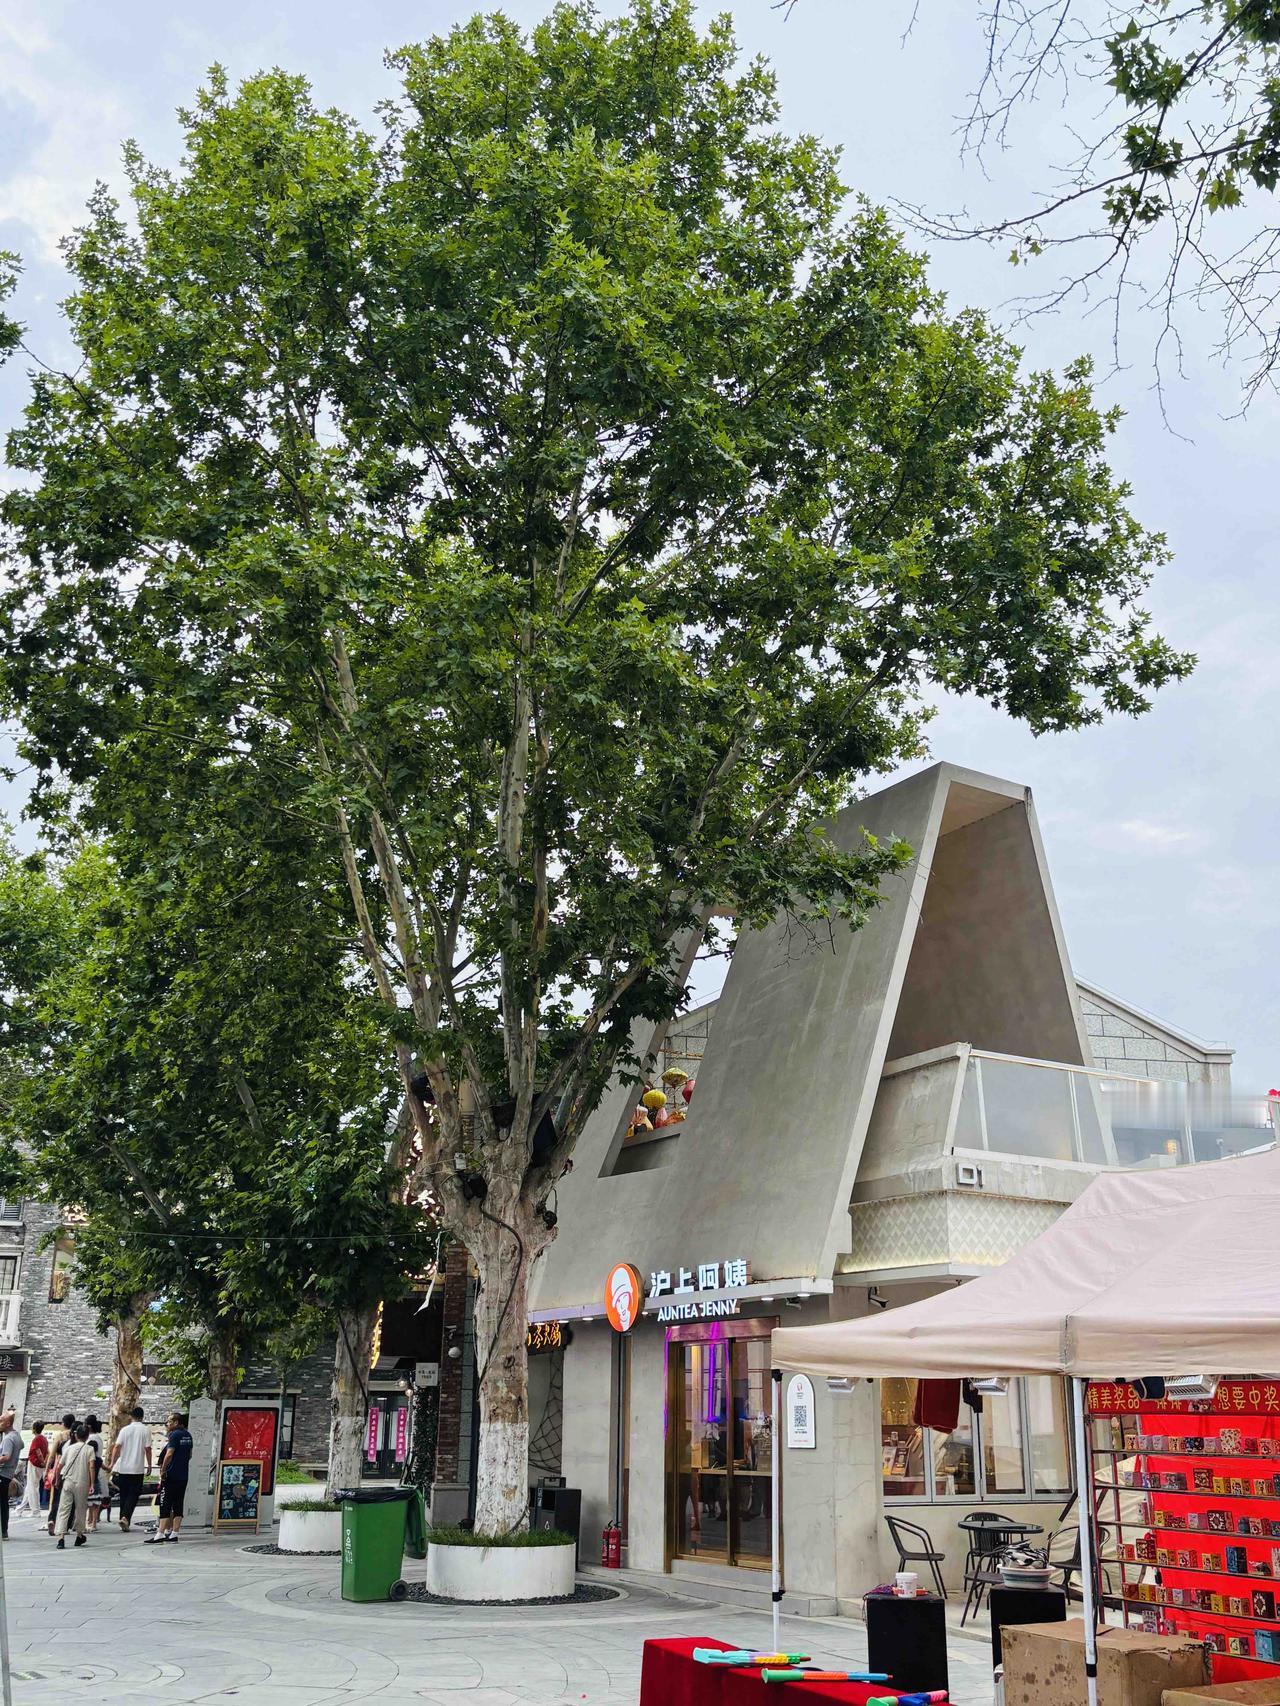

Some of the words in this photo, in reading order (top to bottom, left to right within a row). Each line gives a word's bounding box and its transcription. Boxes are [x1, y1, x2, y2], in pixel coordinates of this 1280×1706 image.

[649, 1258, 747, 1298] 沪上阿姨
[657, 1303, 699, 1322] AUNTEA
[700, 1299, 738, 1318] JENNY
[1087, 1385, 1140, 1410] 精美奖品
[1217, 1385, 1280, 1411] 想要中奖
